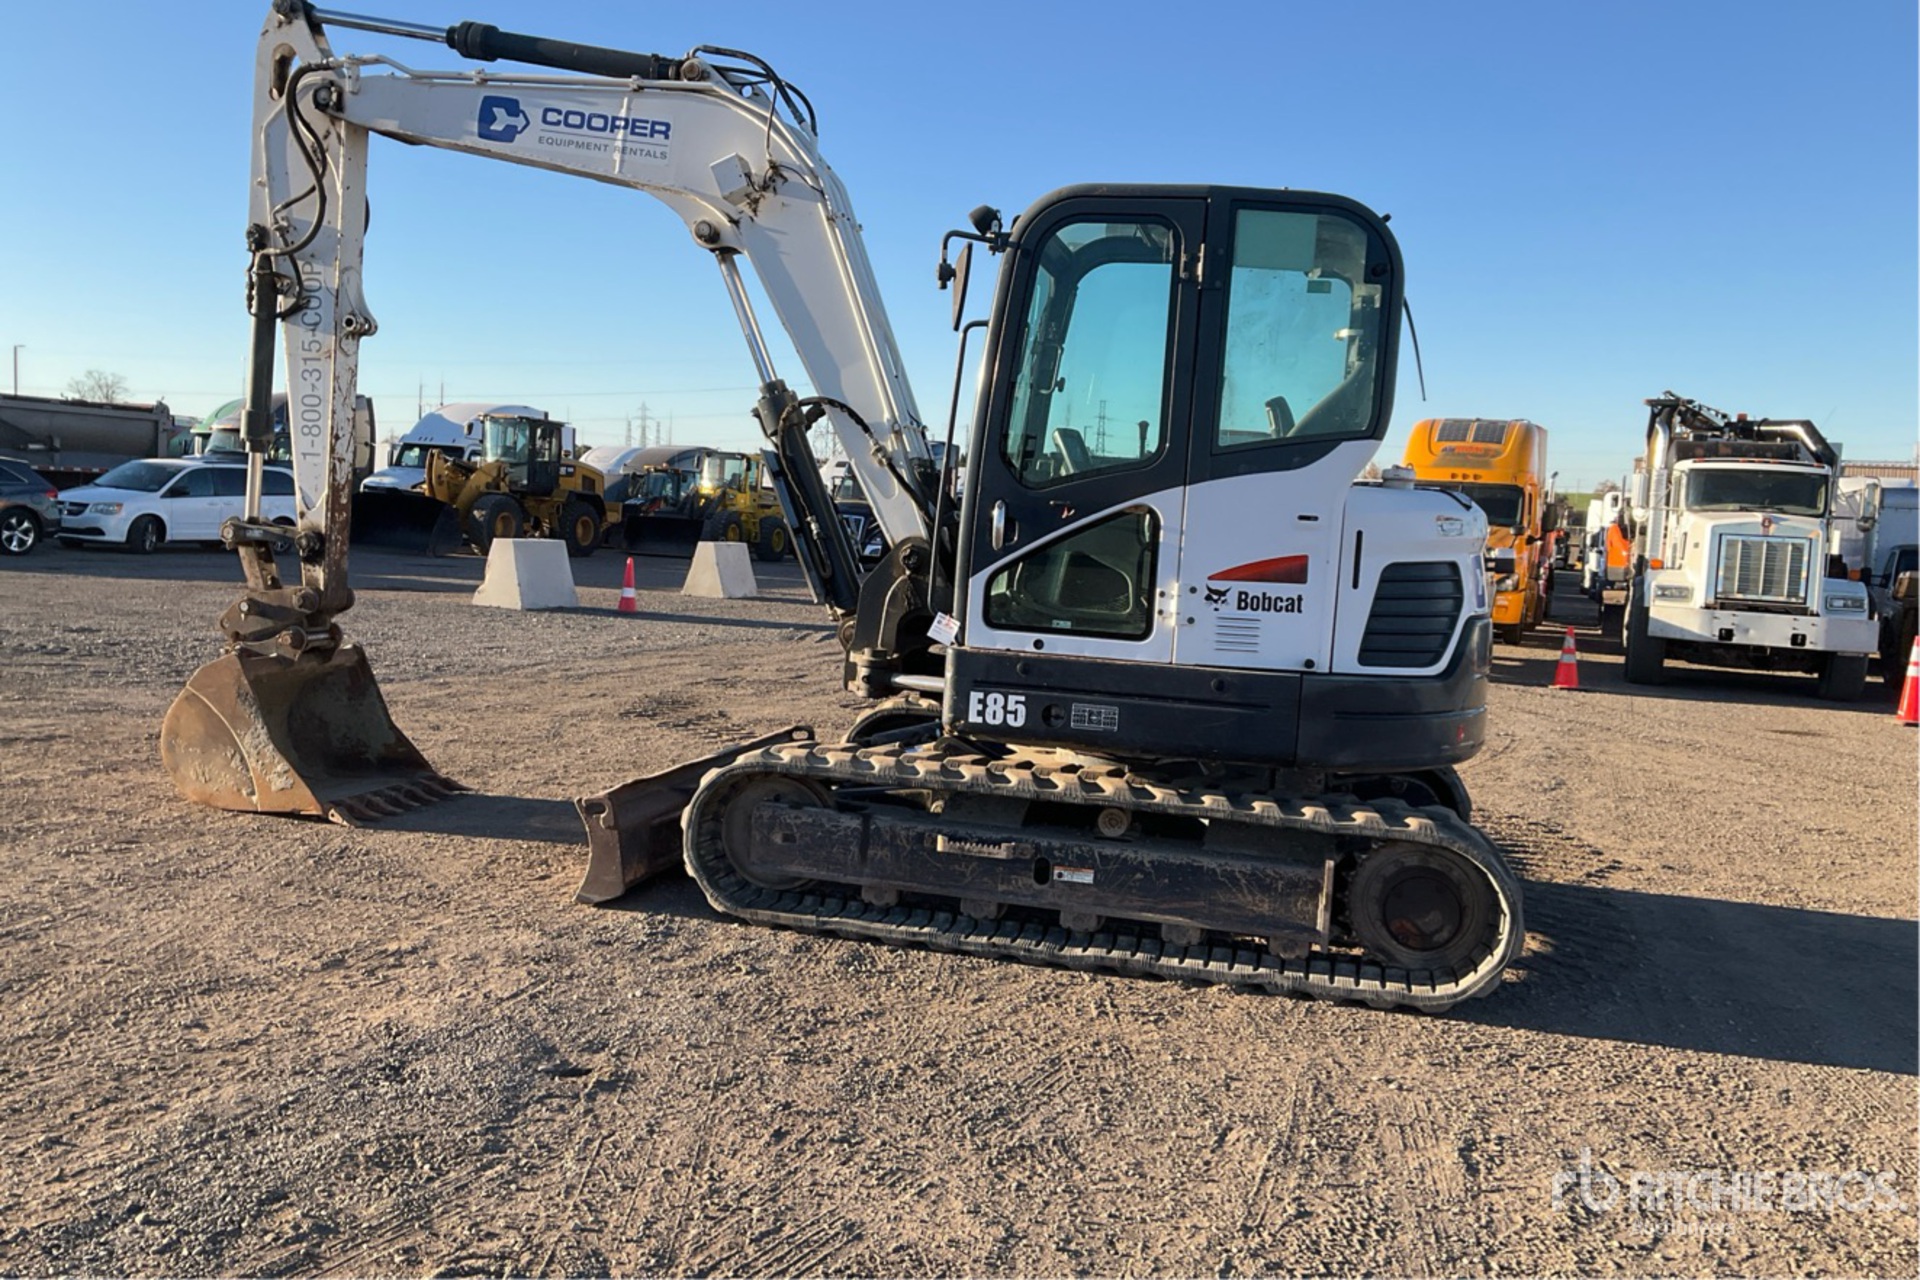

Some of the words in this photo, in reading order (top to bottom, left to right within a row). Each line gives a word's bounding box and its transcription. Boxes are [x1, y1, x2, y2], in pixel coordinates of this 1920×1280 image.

[541, 107, 671, 140] COOPER
[538, 136, 609, 152] EQUIPMENT
[614, 146, 668, 160] RENTALS
[1236, 590, 1303, 614] Bobcat
[968, 691, 1026, 727] E85
